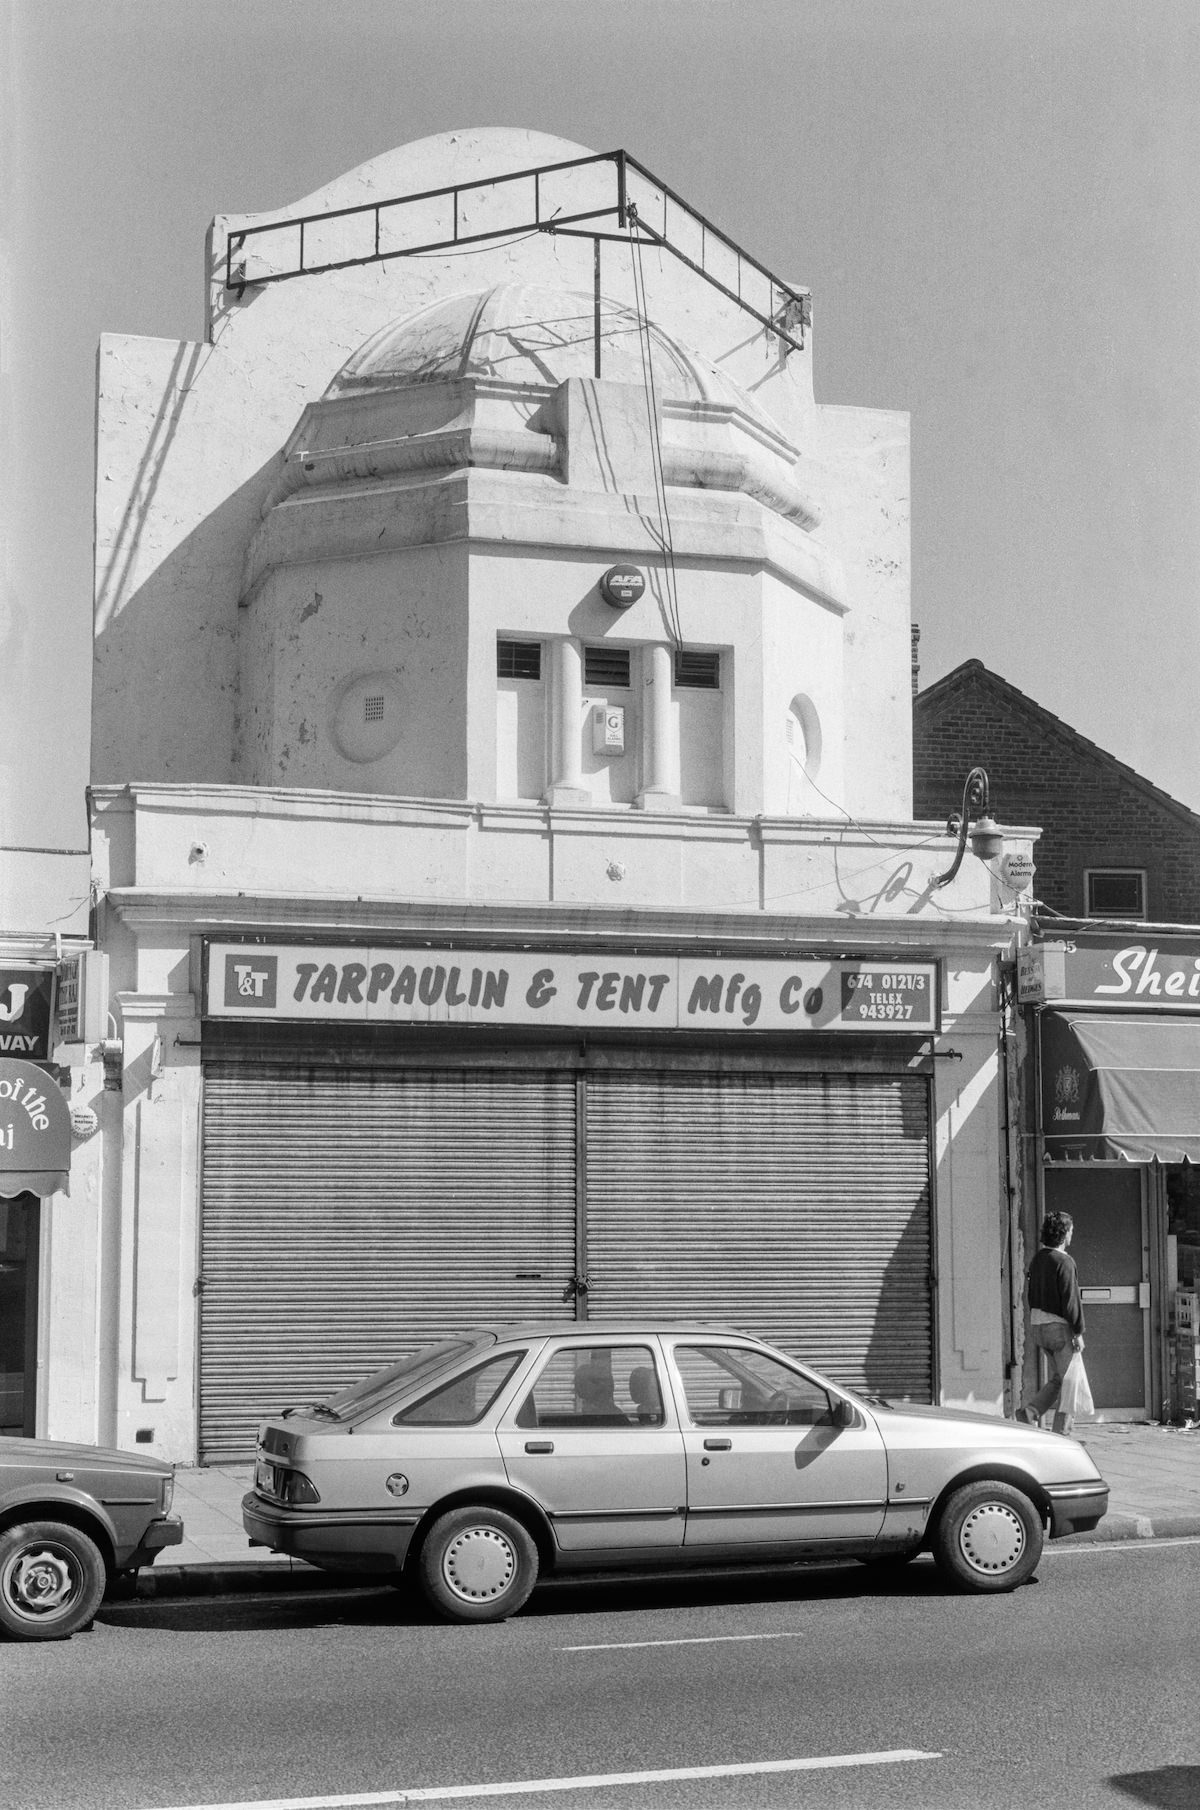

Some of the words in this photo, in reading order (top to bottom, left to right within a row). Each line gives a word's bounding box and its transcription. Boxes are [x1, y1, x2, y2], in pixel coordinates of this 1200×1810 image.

[608, 716, 618, 728] G
[234, 965, 269, 997] T&T
[847, 974, 873, 989] 674
[881, 974, 925, 991] 0121/3
[292, 963, 510, 1009] TARPAULIN
[525, 968, 558, 1009] &
[576, 971, 670, 1013] TENT
[687, 973, 762, 1026] Mfg
[779, 975, 824, 1015] Co
[869, 993, 902, 1004] TELEX
[860, 1004, 914, 1019] 943927
[0, 1077, 25, 1102] of
[21, 1087, 50, 1131] the
